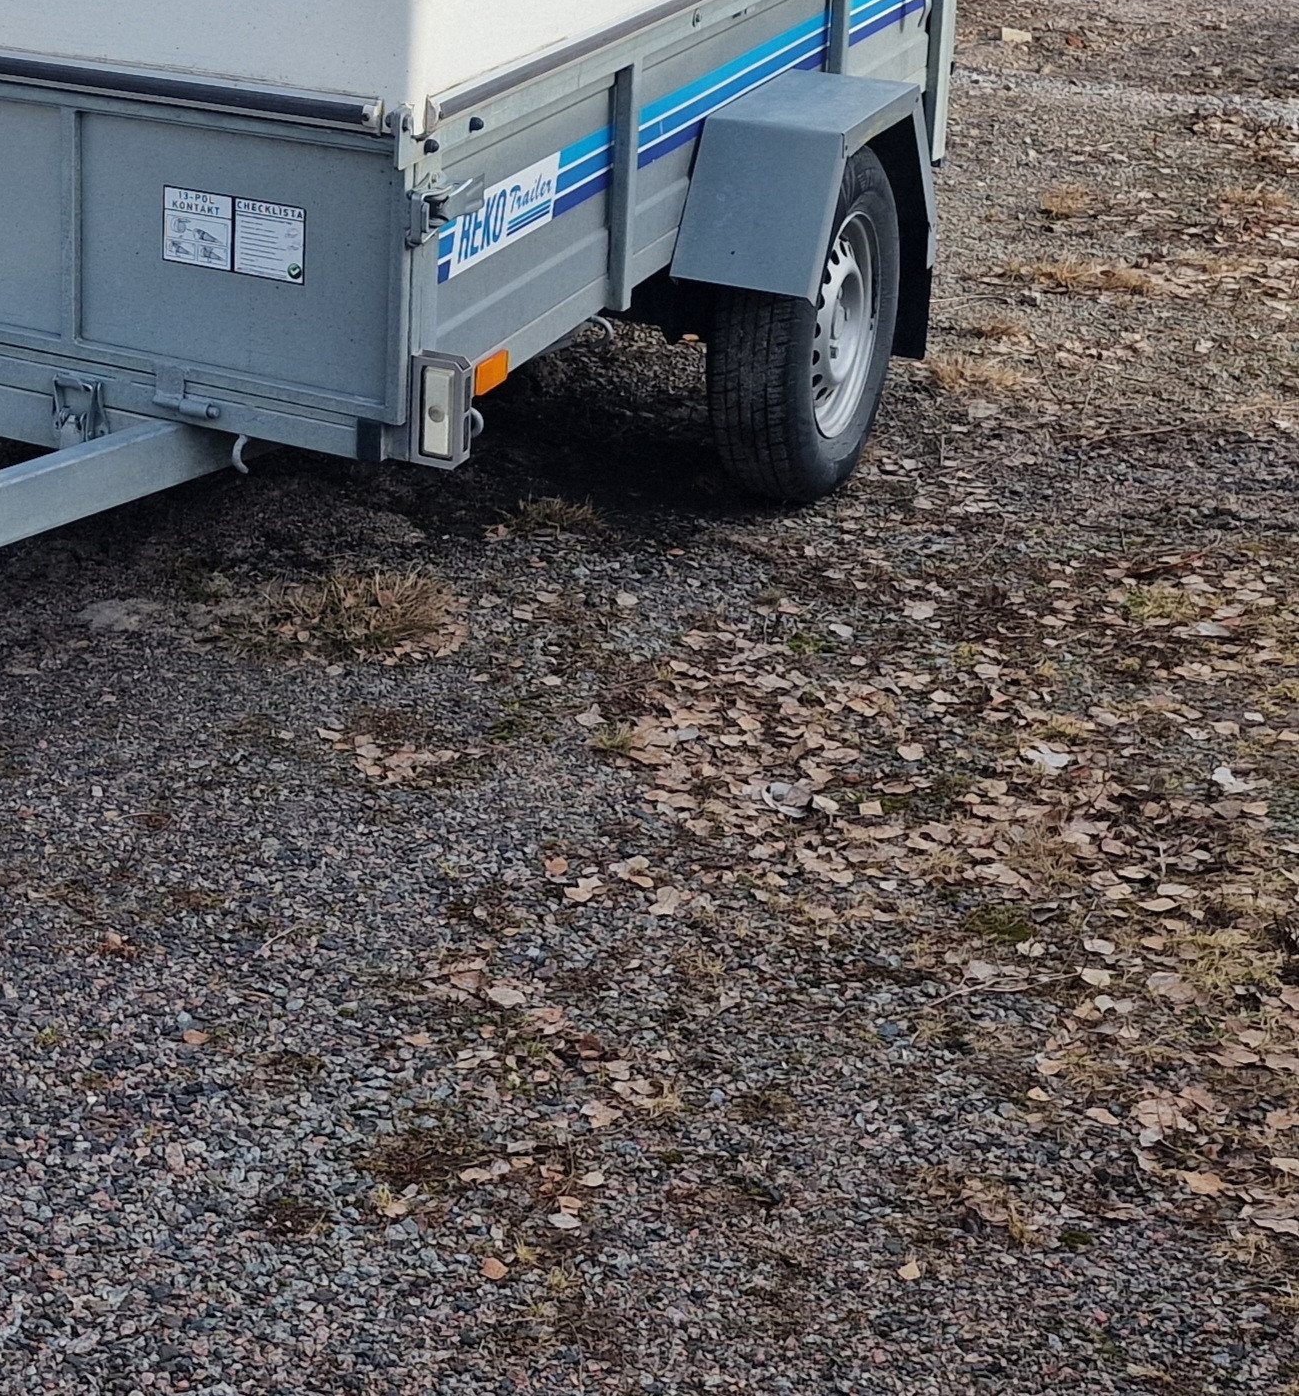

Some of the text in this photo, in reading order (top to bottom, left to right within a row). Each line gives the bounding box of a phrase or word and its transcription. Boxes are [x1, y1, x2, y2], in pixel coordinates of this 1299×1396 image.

[178, 191, 215, 204] 13-POL
[509, 173, 553, 214] Trailer
[172, 200, 221, 215] KONTAKT
[237, 200, 303, 219] CHECKLISTA
